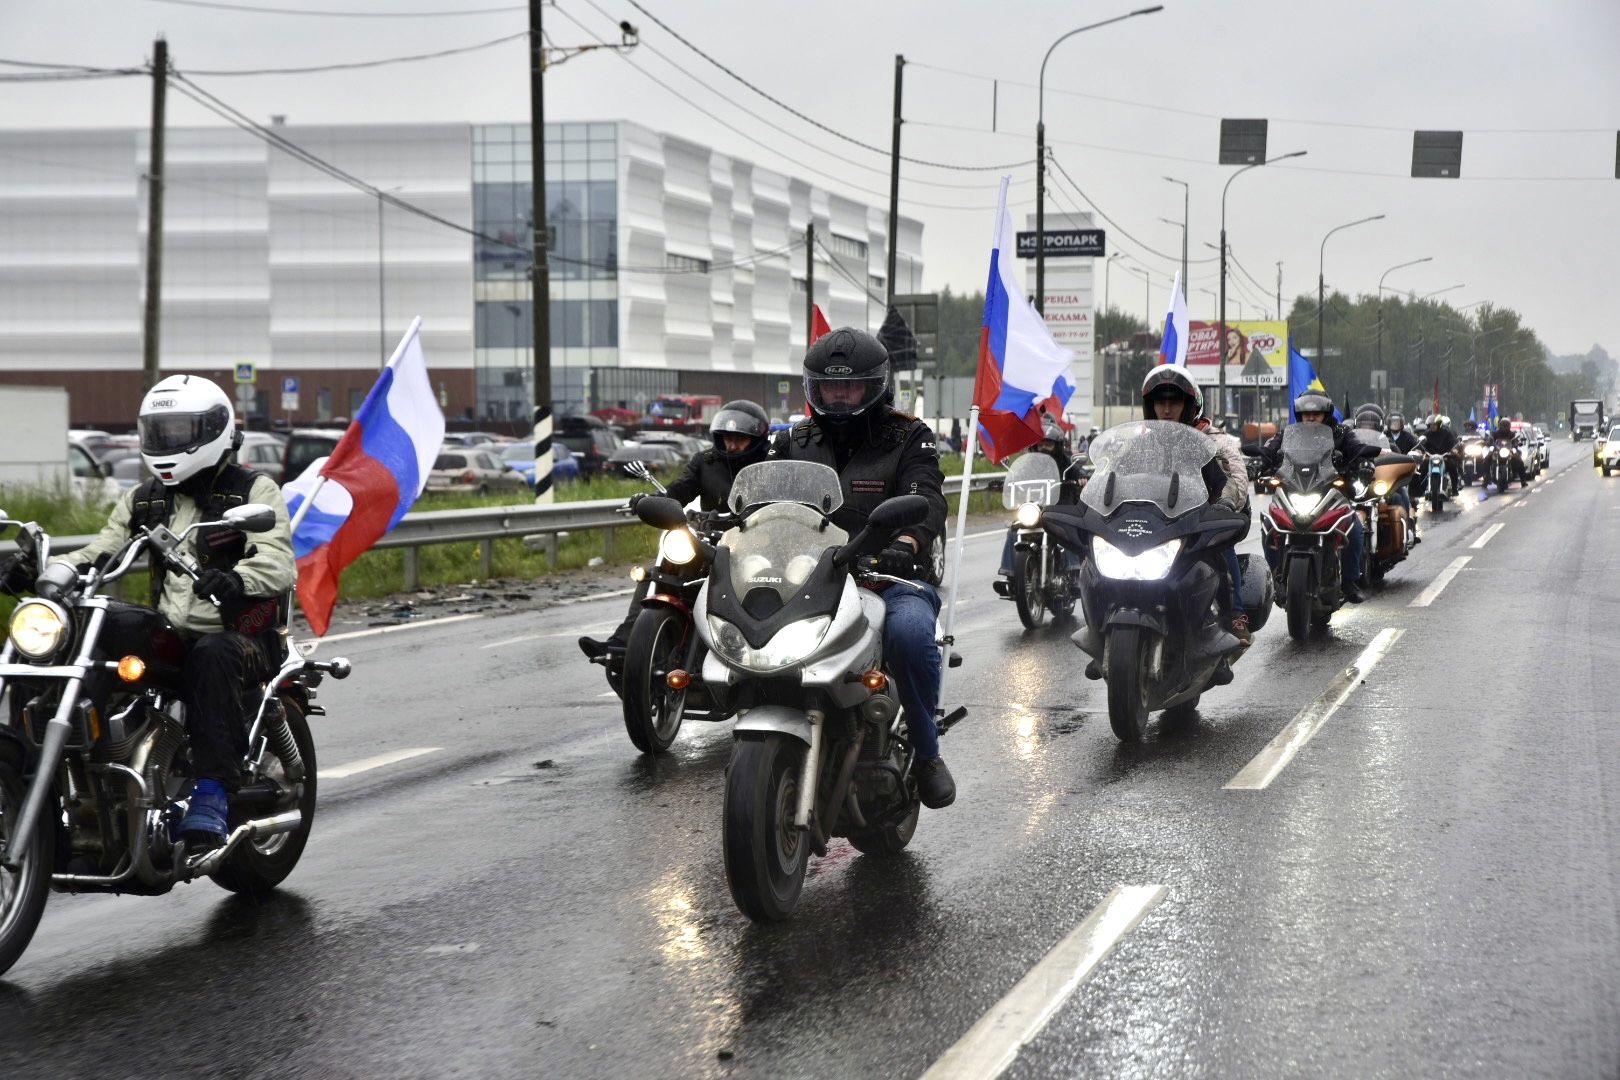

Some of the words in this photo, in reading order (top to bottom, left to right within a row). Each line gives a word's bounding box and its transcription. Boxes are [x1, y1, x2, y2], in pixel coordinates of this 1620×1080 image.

[1044, 295, 1078, 304] РЕНДА
[1044, 313, 1087, 321] ЕКЛАМА
[1190, 330, 1218, 342] ОВАЯ
